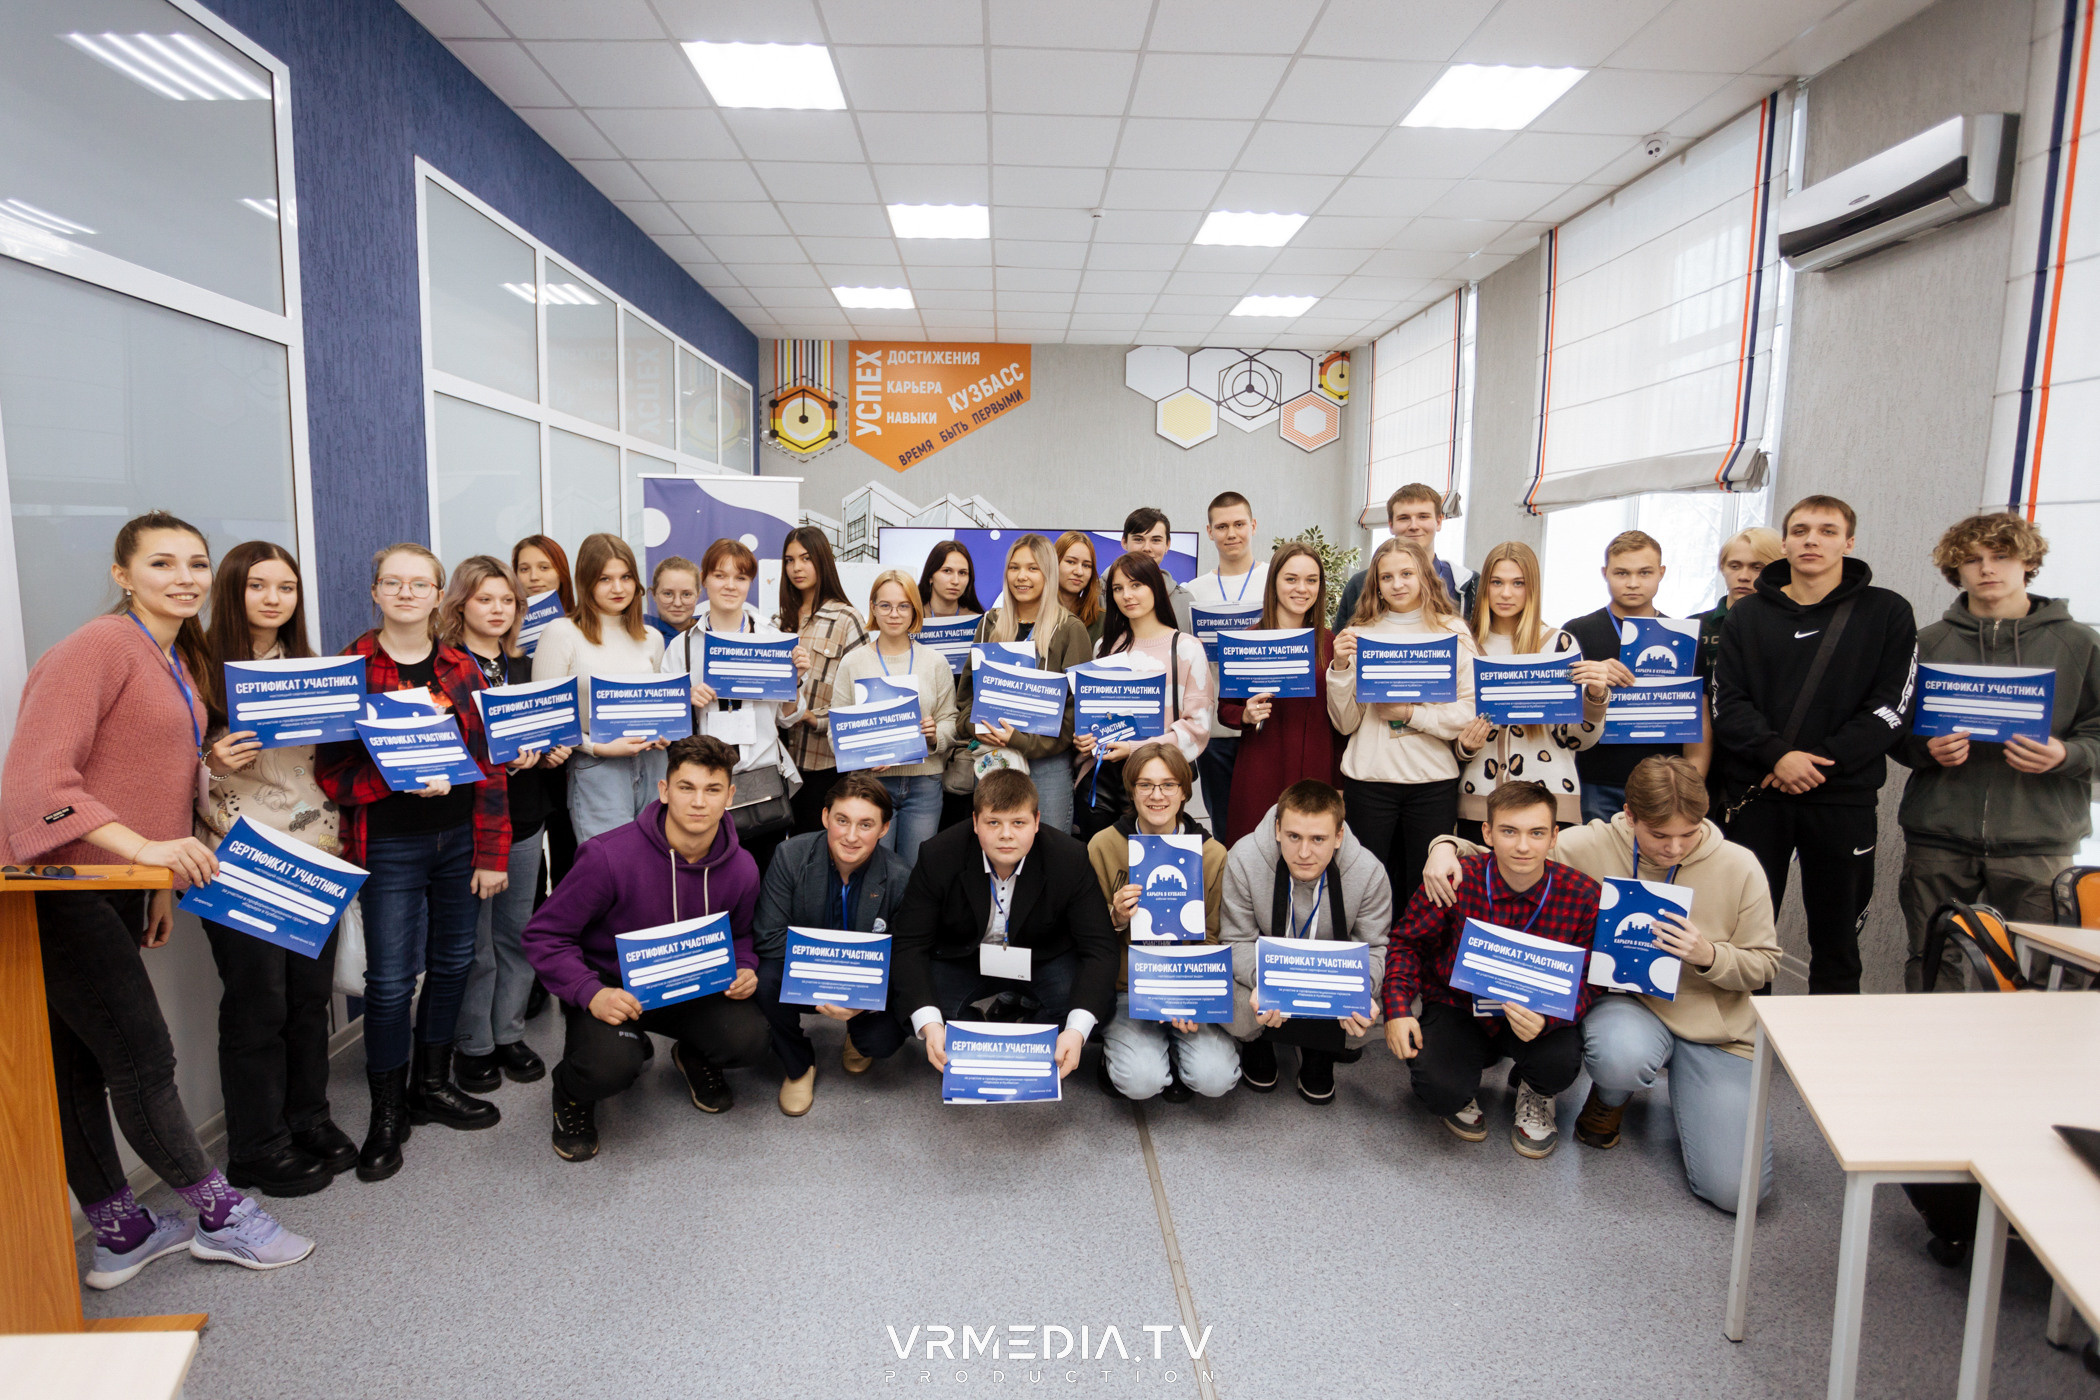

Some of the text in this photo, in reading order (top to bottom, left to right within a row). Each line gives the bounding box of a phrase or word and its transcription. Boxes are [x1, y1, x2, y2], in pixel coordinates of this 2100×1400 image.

[887, 351, 980, 365] ДОСТИЖЕНИЯ
[856, 350, 882, 436] УСПЕХ
[887, 381, 942, 394] КАРЬЕРА
[947, 362, 1024, 414] КУЗБАСС
[887, 412, 938, 424] НАВЫКИ
[898, 389, 1024, 466] ВРЕМЯ БЫТЬ ПЕРВЫМИ
[524, 606, 558, 622] ЧАСТНИКА
[1196, 618, 1260, 626] СЕРТИФИКАТ УЧАСТНИ
[908, 630, 943, 640] ЕРТИФИКАТ
[709, 647, 792, 658] СЕРТИФИКАТ УЧАСТНИКА
[1223, 645, 1309, 656] СЕРТИФИКАТ УЧАСТНИКА
[1362, 650, 1451, 659] СЕРТИФИКАТ УЧАСТНИКА
[1480, 669, 1569, 681] СЕРТИФИКАТ УЧАСТНИ
[236, 675, 358, 694] СЕРТИФИКАТ УЧАСТНИКА
[982, 675, 1023, 690] СЕРТИФИКАТ
[1025, 683, 1062, 697] УЧАСТНИКА
[1080, 686, 1160, 695] СЕРТИФИКАТ УЧАСТНИКА
[1925, 680, 1986, 694] СЕРТИФИКАТ
[1988, 683, 2045, 697] УЧАСТНИКА
[596, 688, 685, 700] СЕРТИФИКАТ УЧАСТНИКА
[1610, 692, 1696, 702] ЕРТИФИКАТ УЧАСТНИКА
[488, 700, 534, 716] СЕРТИФИКАТ
[534, 692, 573, 707] УЧАСТНИКА
[836, 718, 878, 732] СЕРТИФИКАТ
[879, 712, 916, 725] УЧАСТНИКА
[1873, 706, 1902, 729] NIKE
[1100, 720, 1127, 736] УЧАСТНИК
[369, 732, 458, 746] СЕРТИФИКАТ УЧАСТНИКА
[229, 840, 347, 900] СЕРТИФИКАТ УЧАСТНИКА
[626, 942, 678, 962] СЕРТИФИКАТ
[680, 931, 726, 950] УЧАСТНИКА
[792, 944, 840, 958] СЕРТИФИКАТ
[841, 948, 884, 962] УЧАСТНИКА
[1265, 954, 1316, 966] СЕРТИФИКАТ
[1317, 956, 1363, 970] УЧАСТНИКА
[1468, 936, 1522, 960] СЕРТИФИКАТ
[1524, 950, 1574, 974] УЧАСТНИКА
[1134, 962, 1226, 973] СЕРТИФИКАТ УЧАСТНИКА
[952, 1041, 1050, 1054] СЕРТИФИКАТ УЧАСТНИКА
